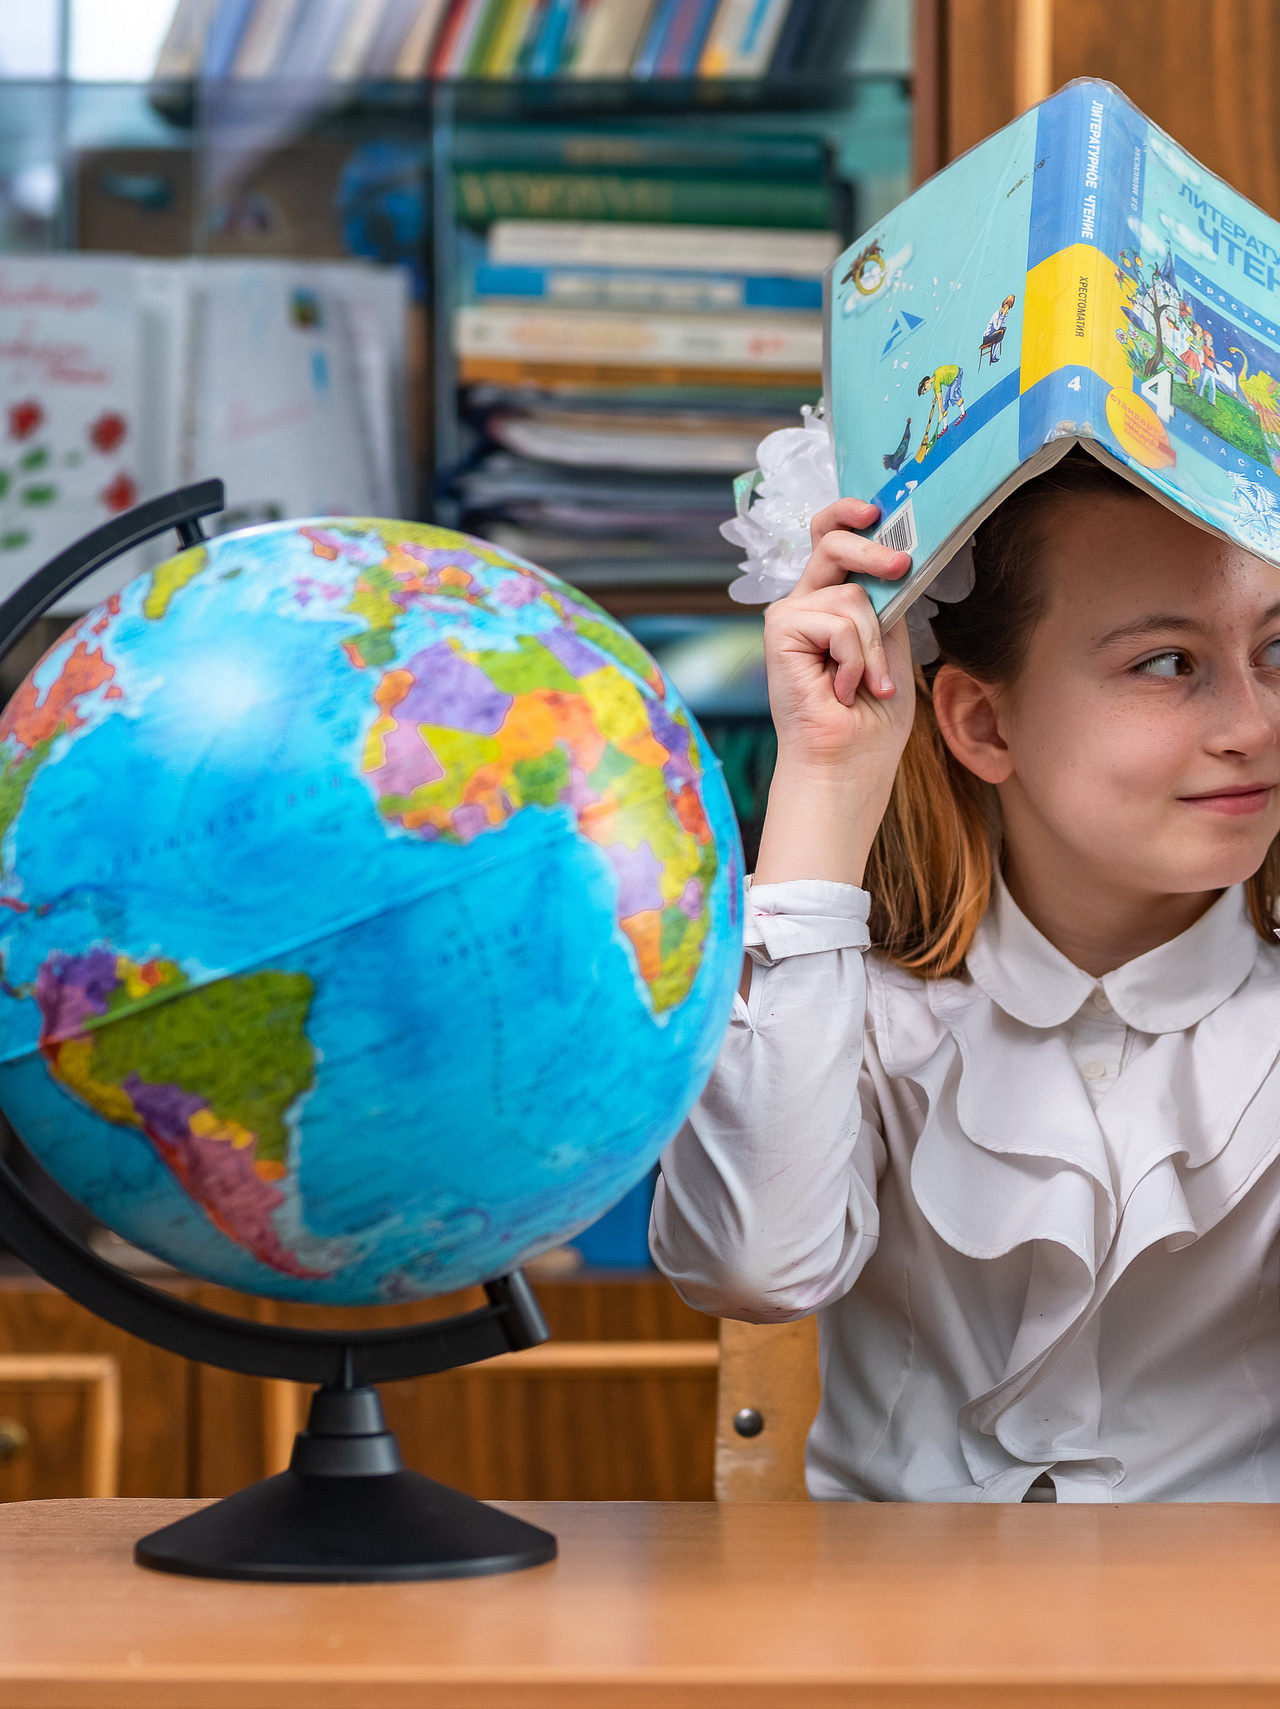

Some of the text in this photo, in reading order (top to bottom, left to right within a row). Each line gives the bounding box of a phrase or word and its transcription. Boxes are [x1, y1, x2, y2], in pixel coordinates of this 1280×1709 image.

[1081, 100, 1104, 240] ЛИТЕРАТУРНОЕ ЧТЕНИЕ
[1075, 275, 1088, 338] ХРЕСТОМАТИЯ
[1067, 375, 1082, 392] 4
[1141, 369, 1176, 424] 4
